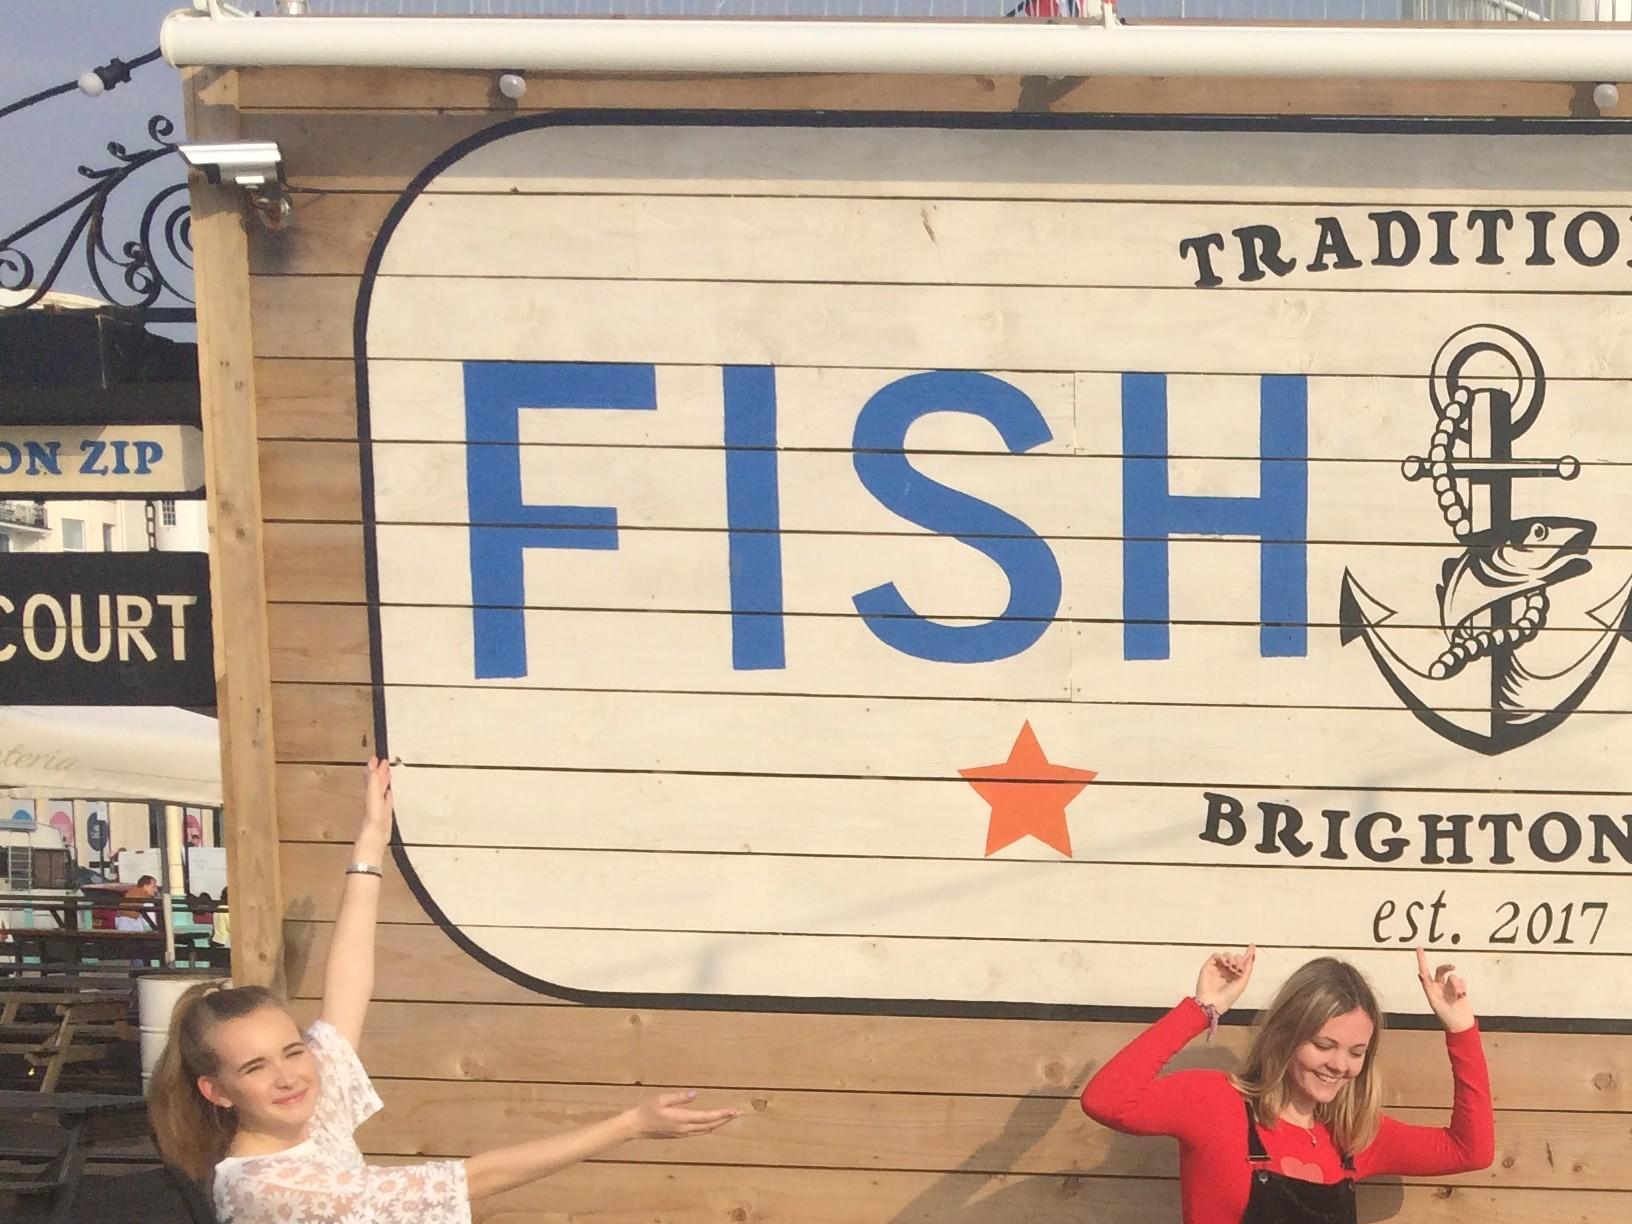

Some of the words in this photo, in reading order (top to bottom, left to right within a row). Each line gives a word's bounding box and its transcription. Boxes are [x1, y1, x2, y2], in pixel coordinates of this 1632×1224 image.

[79, 440, 164, 477] ZIP
[462, 361, 1308, 680] FISH
[1372, 889, 1462, 945] est.
[1488, 901, 1608, 945] 2017
